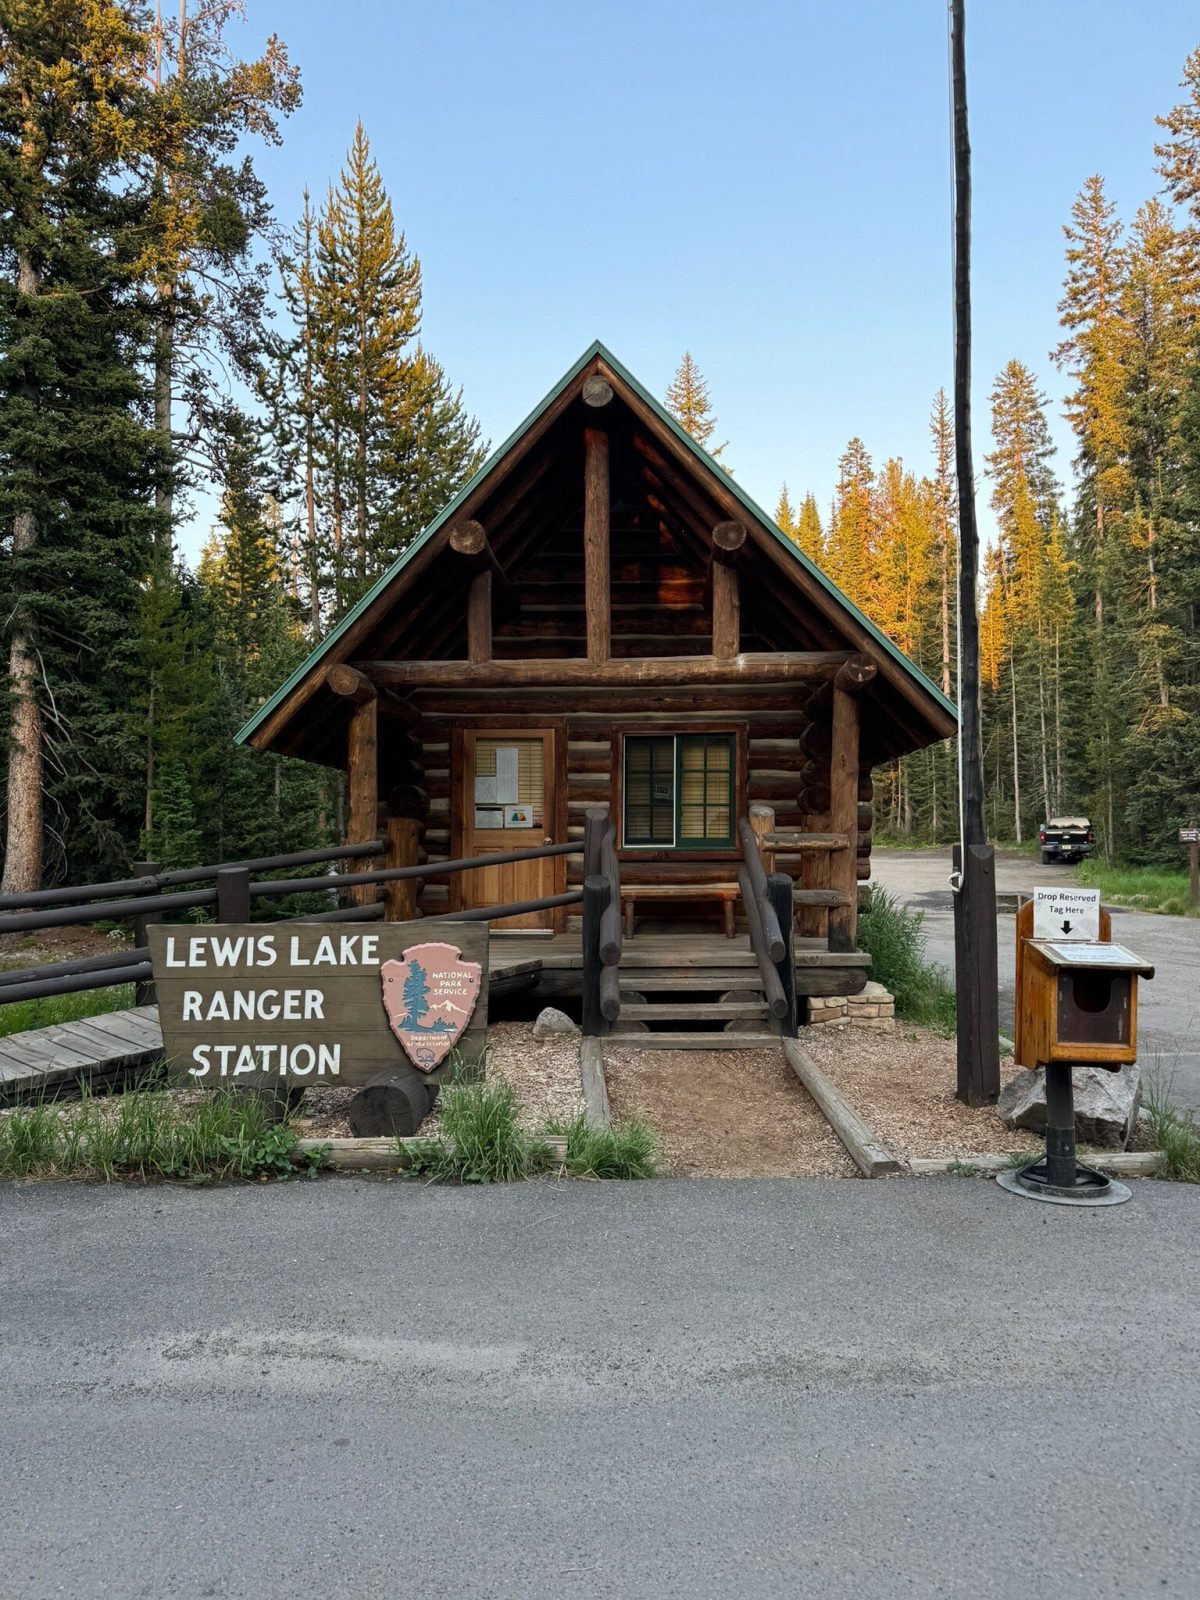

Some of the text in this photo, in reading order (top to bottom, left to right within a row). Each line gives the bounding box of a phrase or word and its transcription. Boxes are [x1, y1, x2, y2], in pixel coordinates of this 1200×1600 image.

[1037, 892, 1097, 902] Drop Reserved
[1049, 905, 1085, 914] Tag Here
[165, 935, 380, 968] LEWIS LAKE
[433, 988, 468, 996] SERVICE
[182, 989, 325, 1021] RANGER
[187, 1043, 341, 1077] STATION
